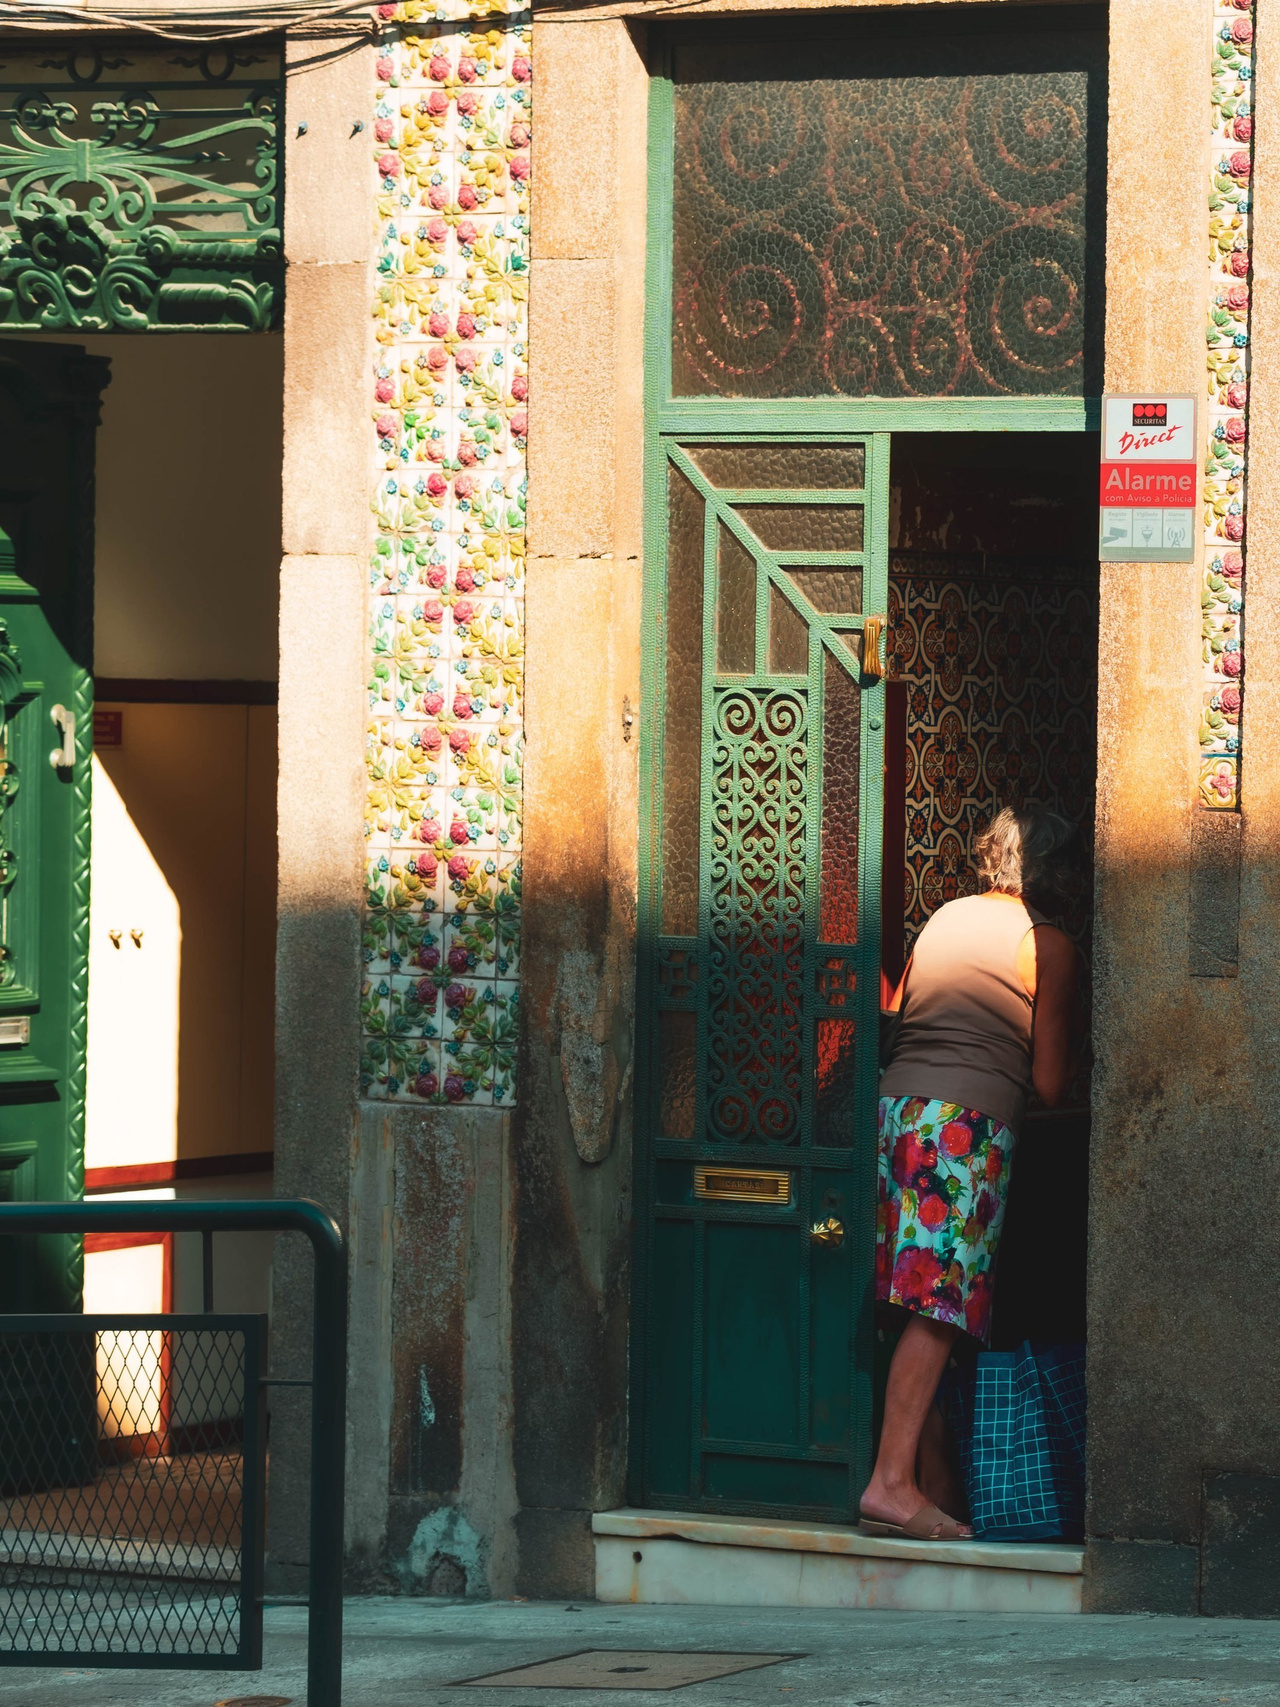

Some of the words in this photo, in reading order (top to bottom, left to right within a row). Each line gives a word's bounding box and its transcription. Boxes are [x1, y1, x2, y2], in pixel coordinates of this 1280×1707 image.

[1118, 425, 1184, 455] Direct
[1105, 467, 1192, 490] Alarme
[1105, 495, 1124, 503] com
[1127, 493, 1152, 503] Aviso
